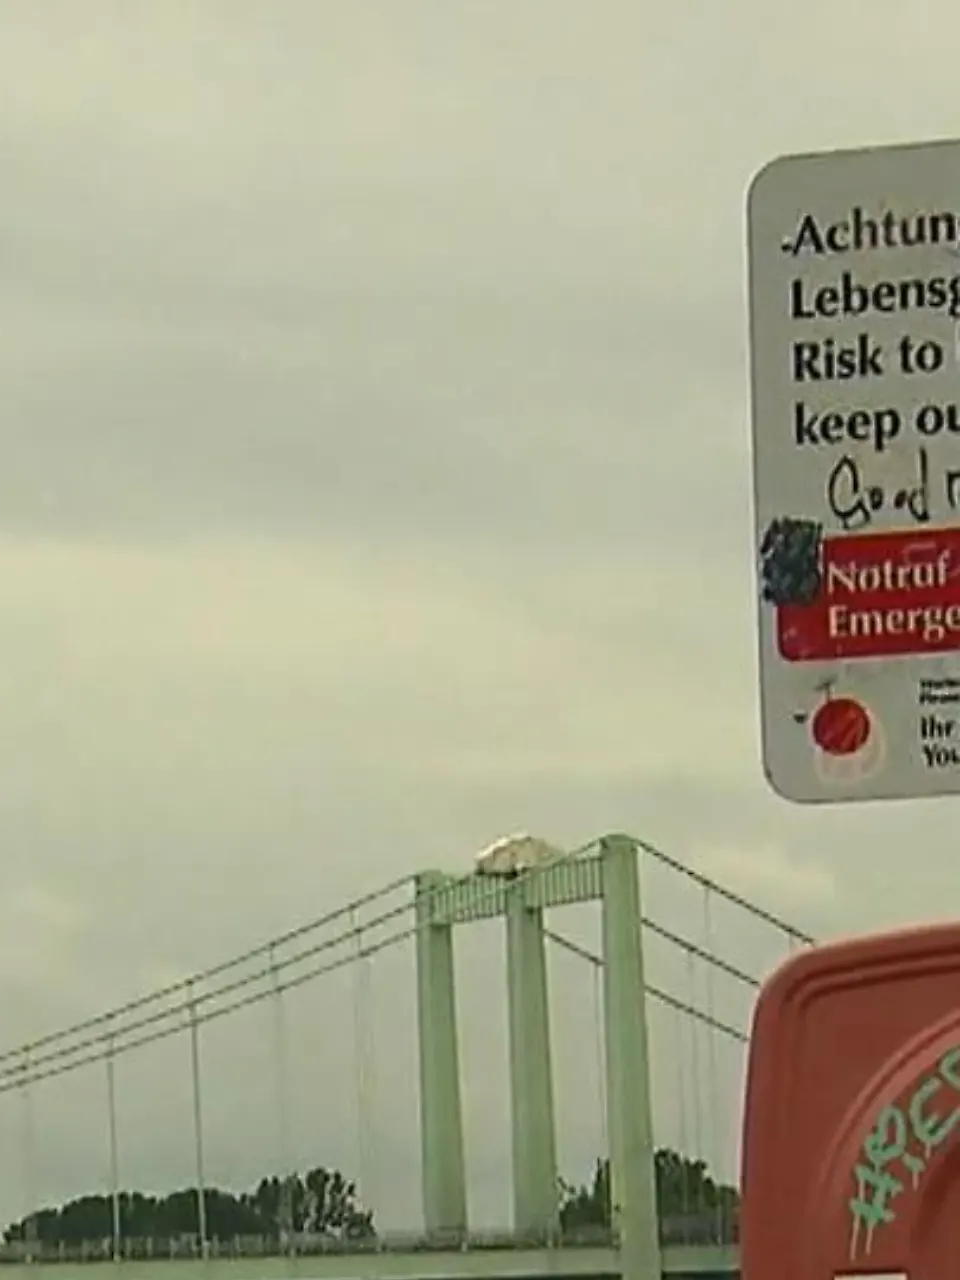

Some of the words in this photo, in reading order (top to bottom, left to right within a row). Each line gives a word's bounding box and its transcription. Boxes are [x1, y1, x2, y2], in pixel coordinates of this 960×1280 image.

[792, 206, 960, 256] Achtun
[793, 333, 883, 382] Risk
[900, 334, 943, 374] to
[795, 401, 901, 452] keep
[827, 549, 950, 595] Notruf
[920, 714, 953, 740] Ihr
